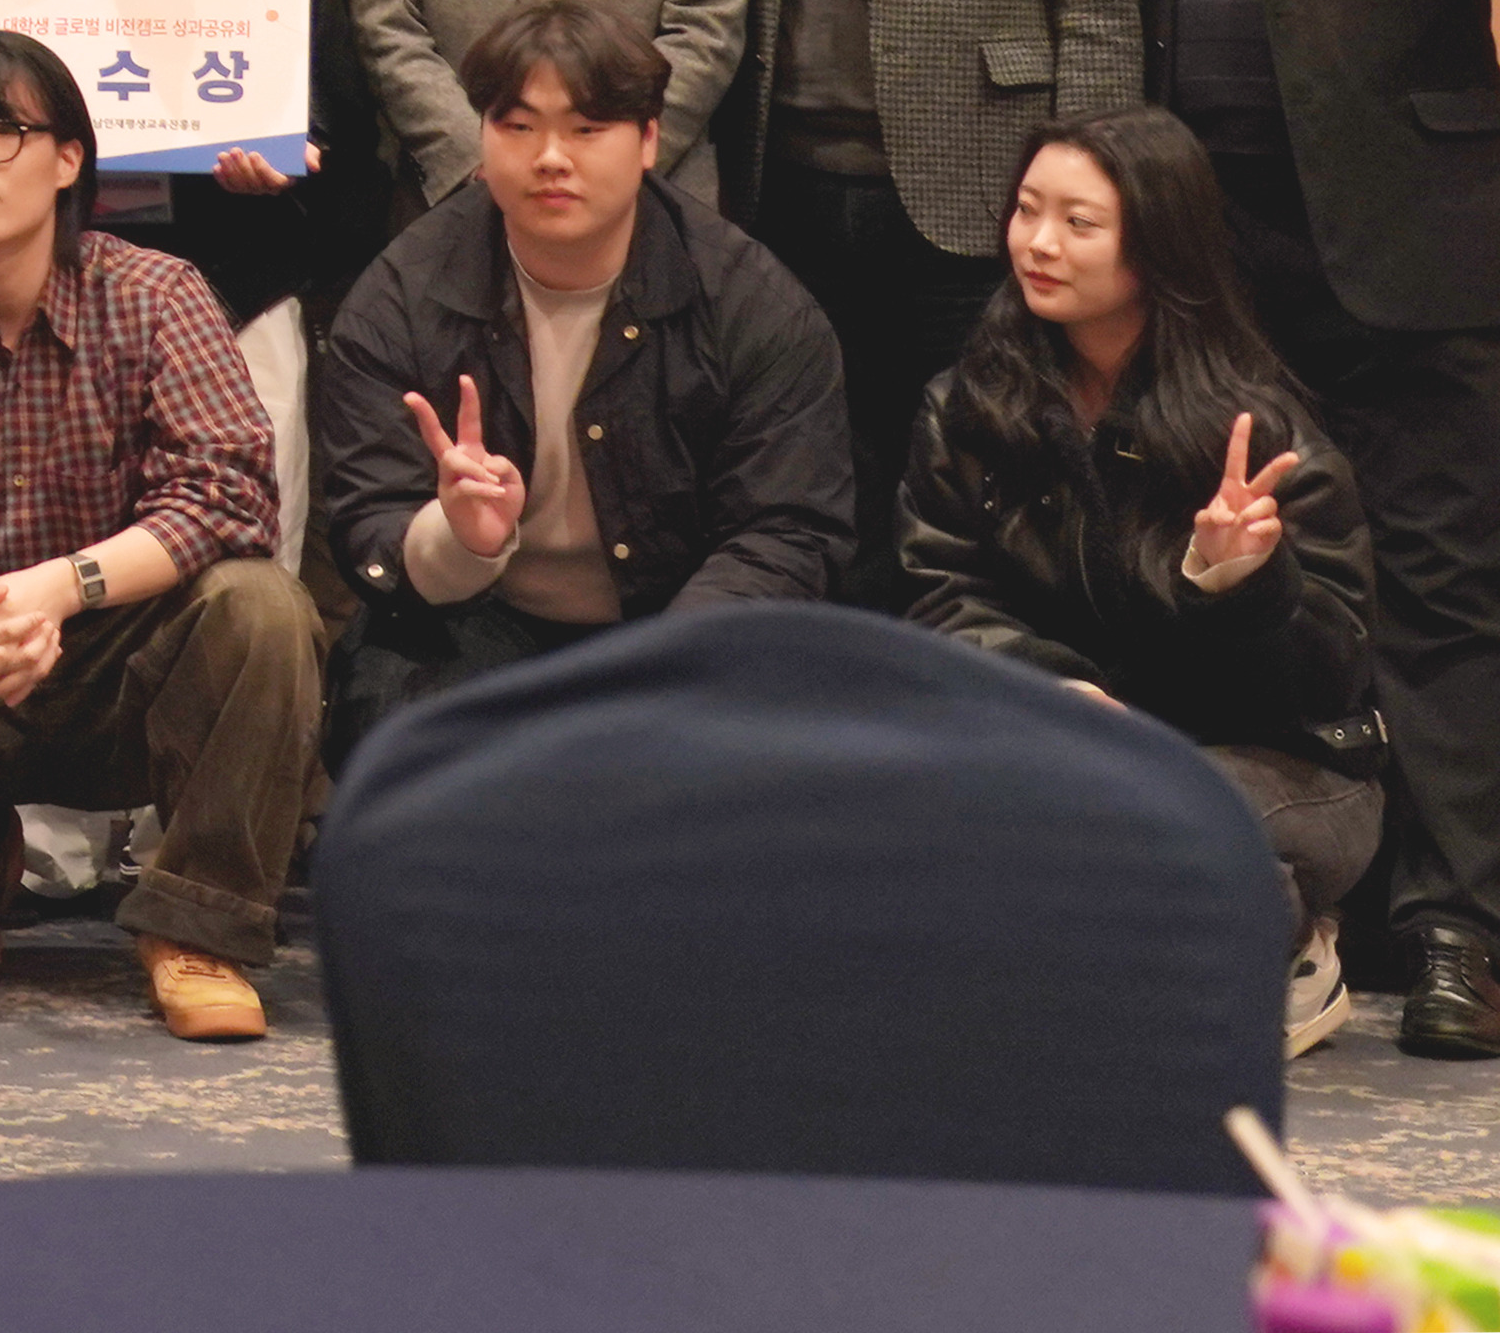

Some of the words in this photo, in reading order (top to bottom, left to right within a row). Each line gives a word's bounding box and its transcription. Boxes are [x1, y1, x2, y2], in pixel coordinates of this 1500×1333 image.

[3, 16, 48, 34] 대학생
[55, 18, 99, 36] 글로벌
[106, 18, 167, 36] 비전캠프
[173, 19, 250, 38] 성과공유회
[93, 118, 200, 131] 남인재평생교육진흥원
